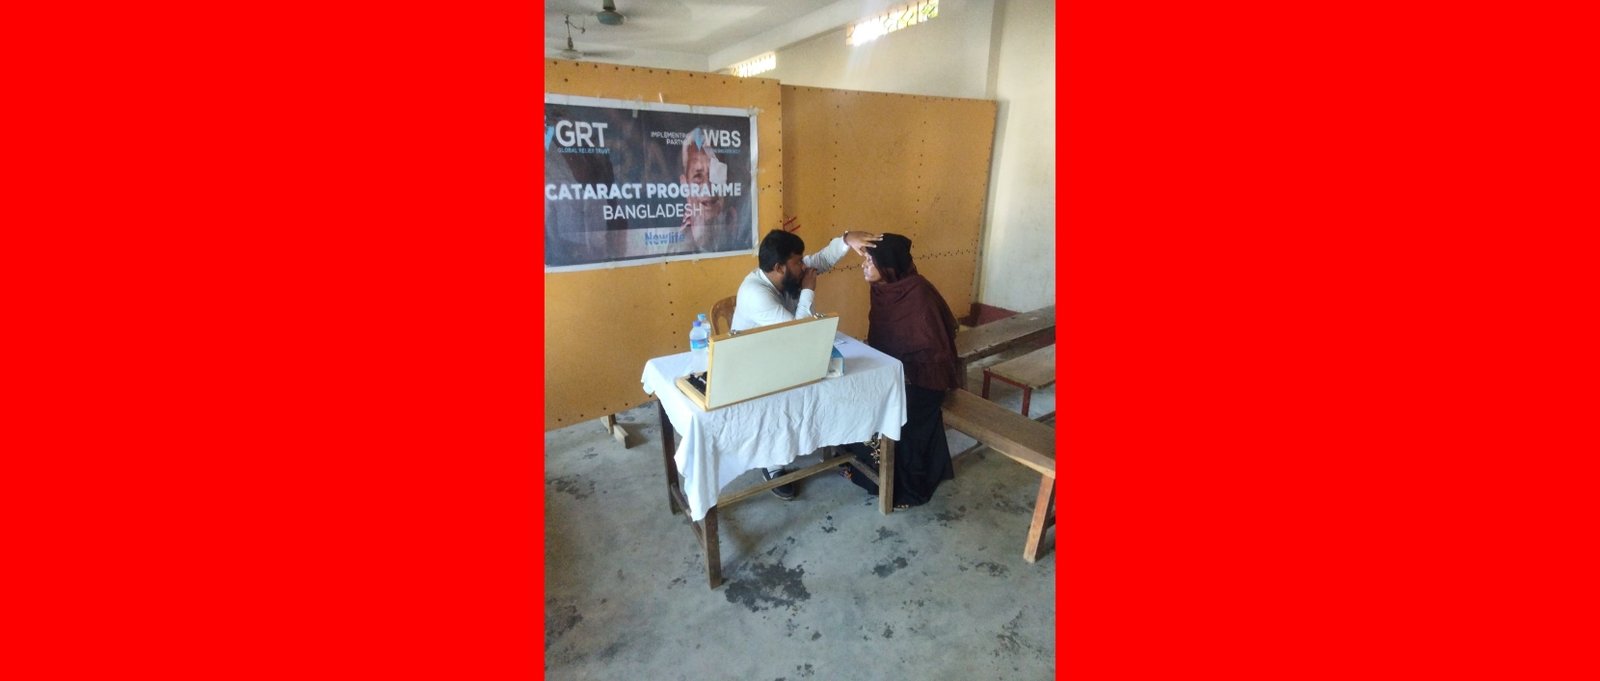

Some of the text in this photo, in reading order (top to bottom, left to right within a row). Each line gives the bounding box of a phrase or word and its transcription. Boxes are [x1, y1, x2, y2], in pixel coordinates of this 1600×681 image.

[555, 120, 608, 147] GRT
[703, 129, 741, 147] WBS
[545, 183, 742, 200] CATARACT PROGRAMME
[603, 203, 702, 220] BANGLADESH
